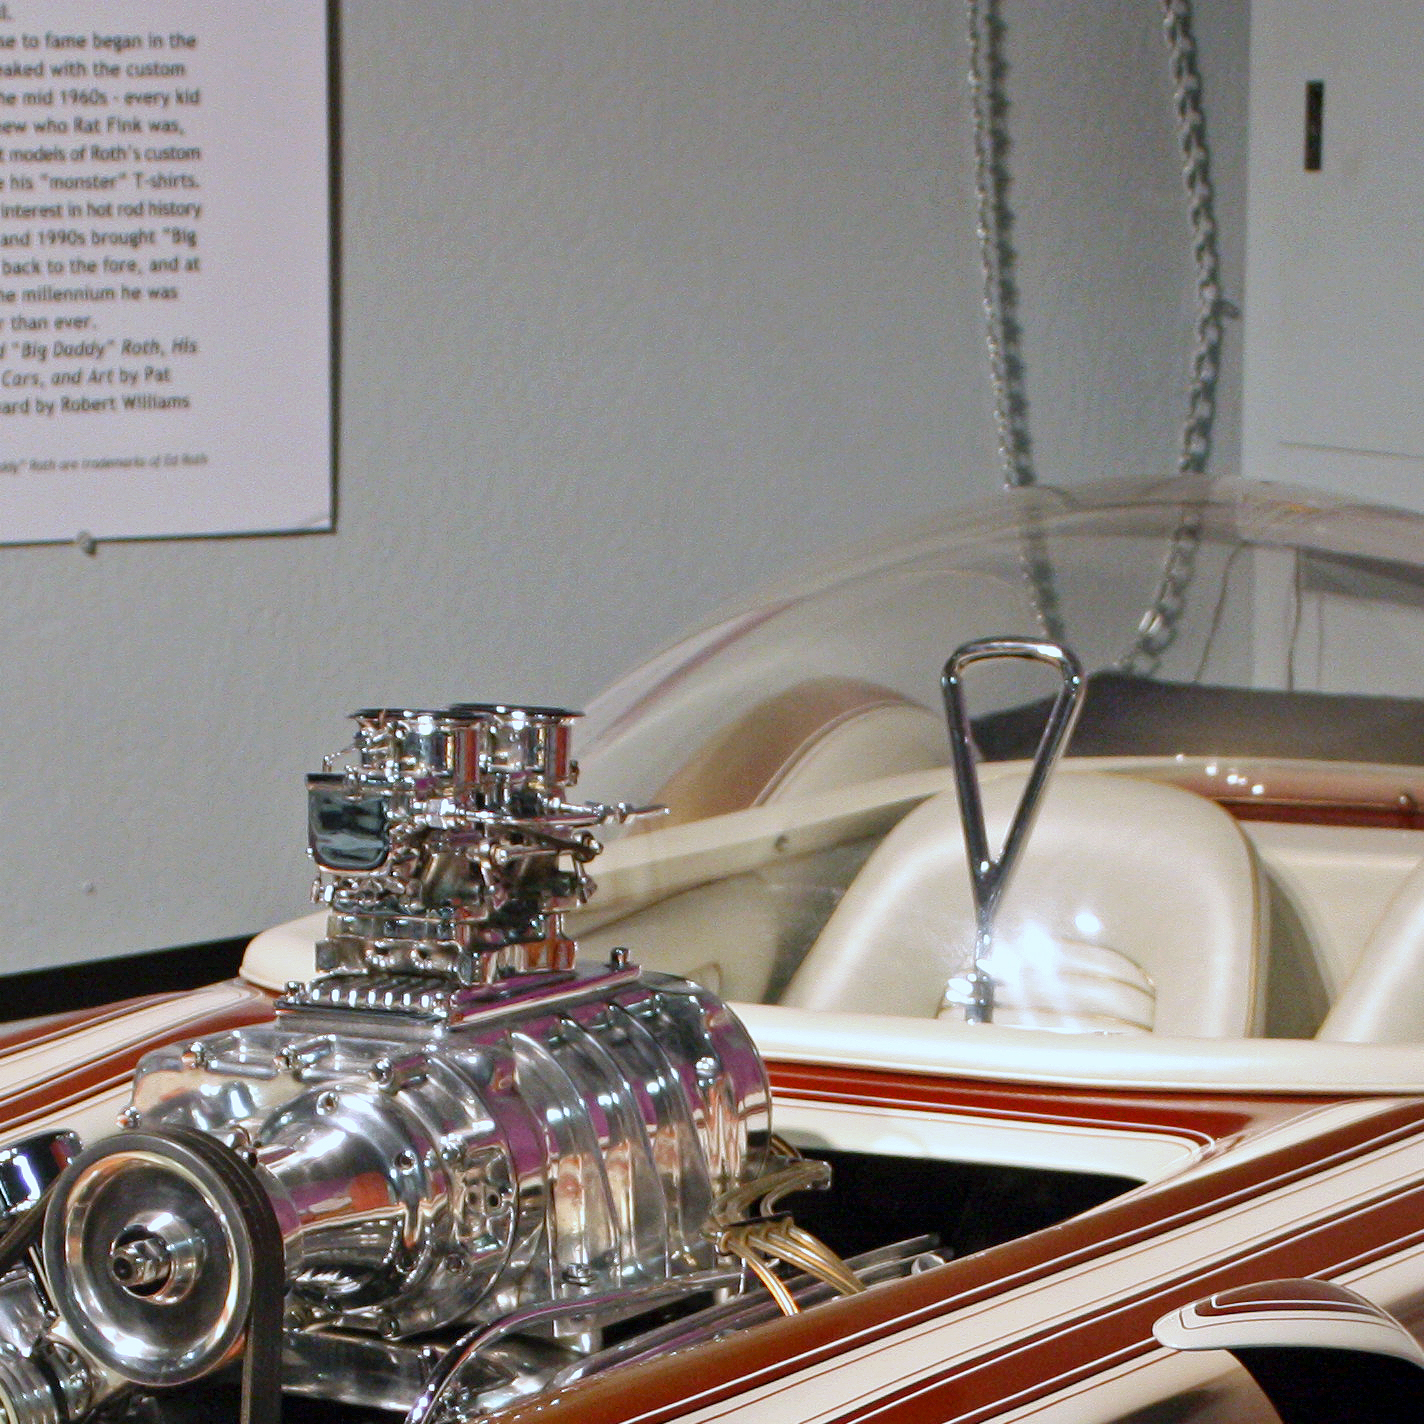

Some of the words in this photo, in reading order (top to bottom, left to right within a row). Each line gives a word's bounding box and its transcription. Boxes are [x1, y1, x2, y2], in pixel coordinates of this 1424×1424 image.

[51, 61, 87, 77] with
[93, 61, 120, 78] the
[126, 62, 186, 78] custom
[9, 175, 34, 191] his
[10, 315, 49, 332] than
[172, 338, 197, 355] His
[35, 399, 56, 417] by
[60, 396, 117, 413] Robert
[121, 394, 191, 410] Williams
